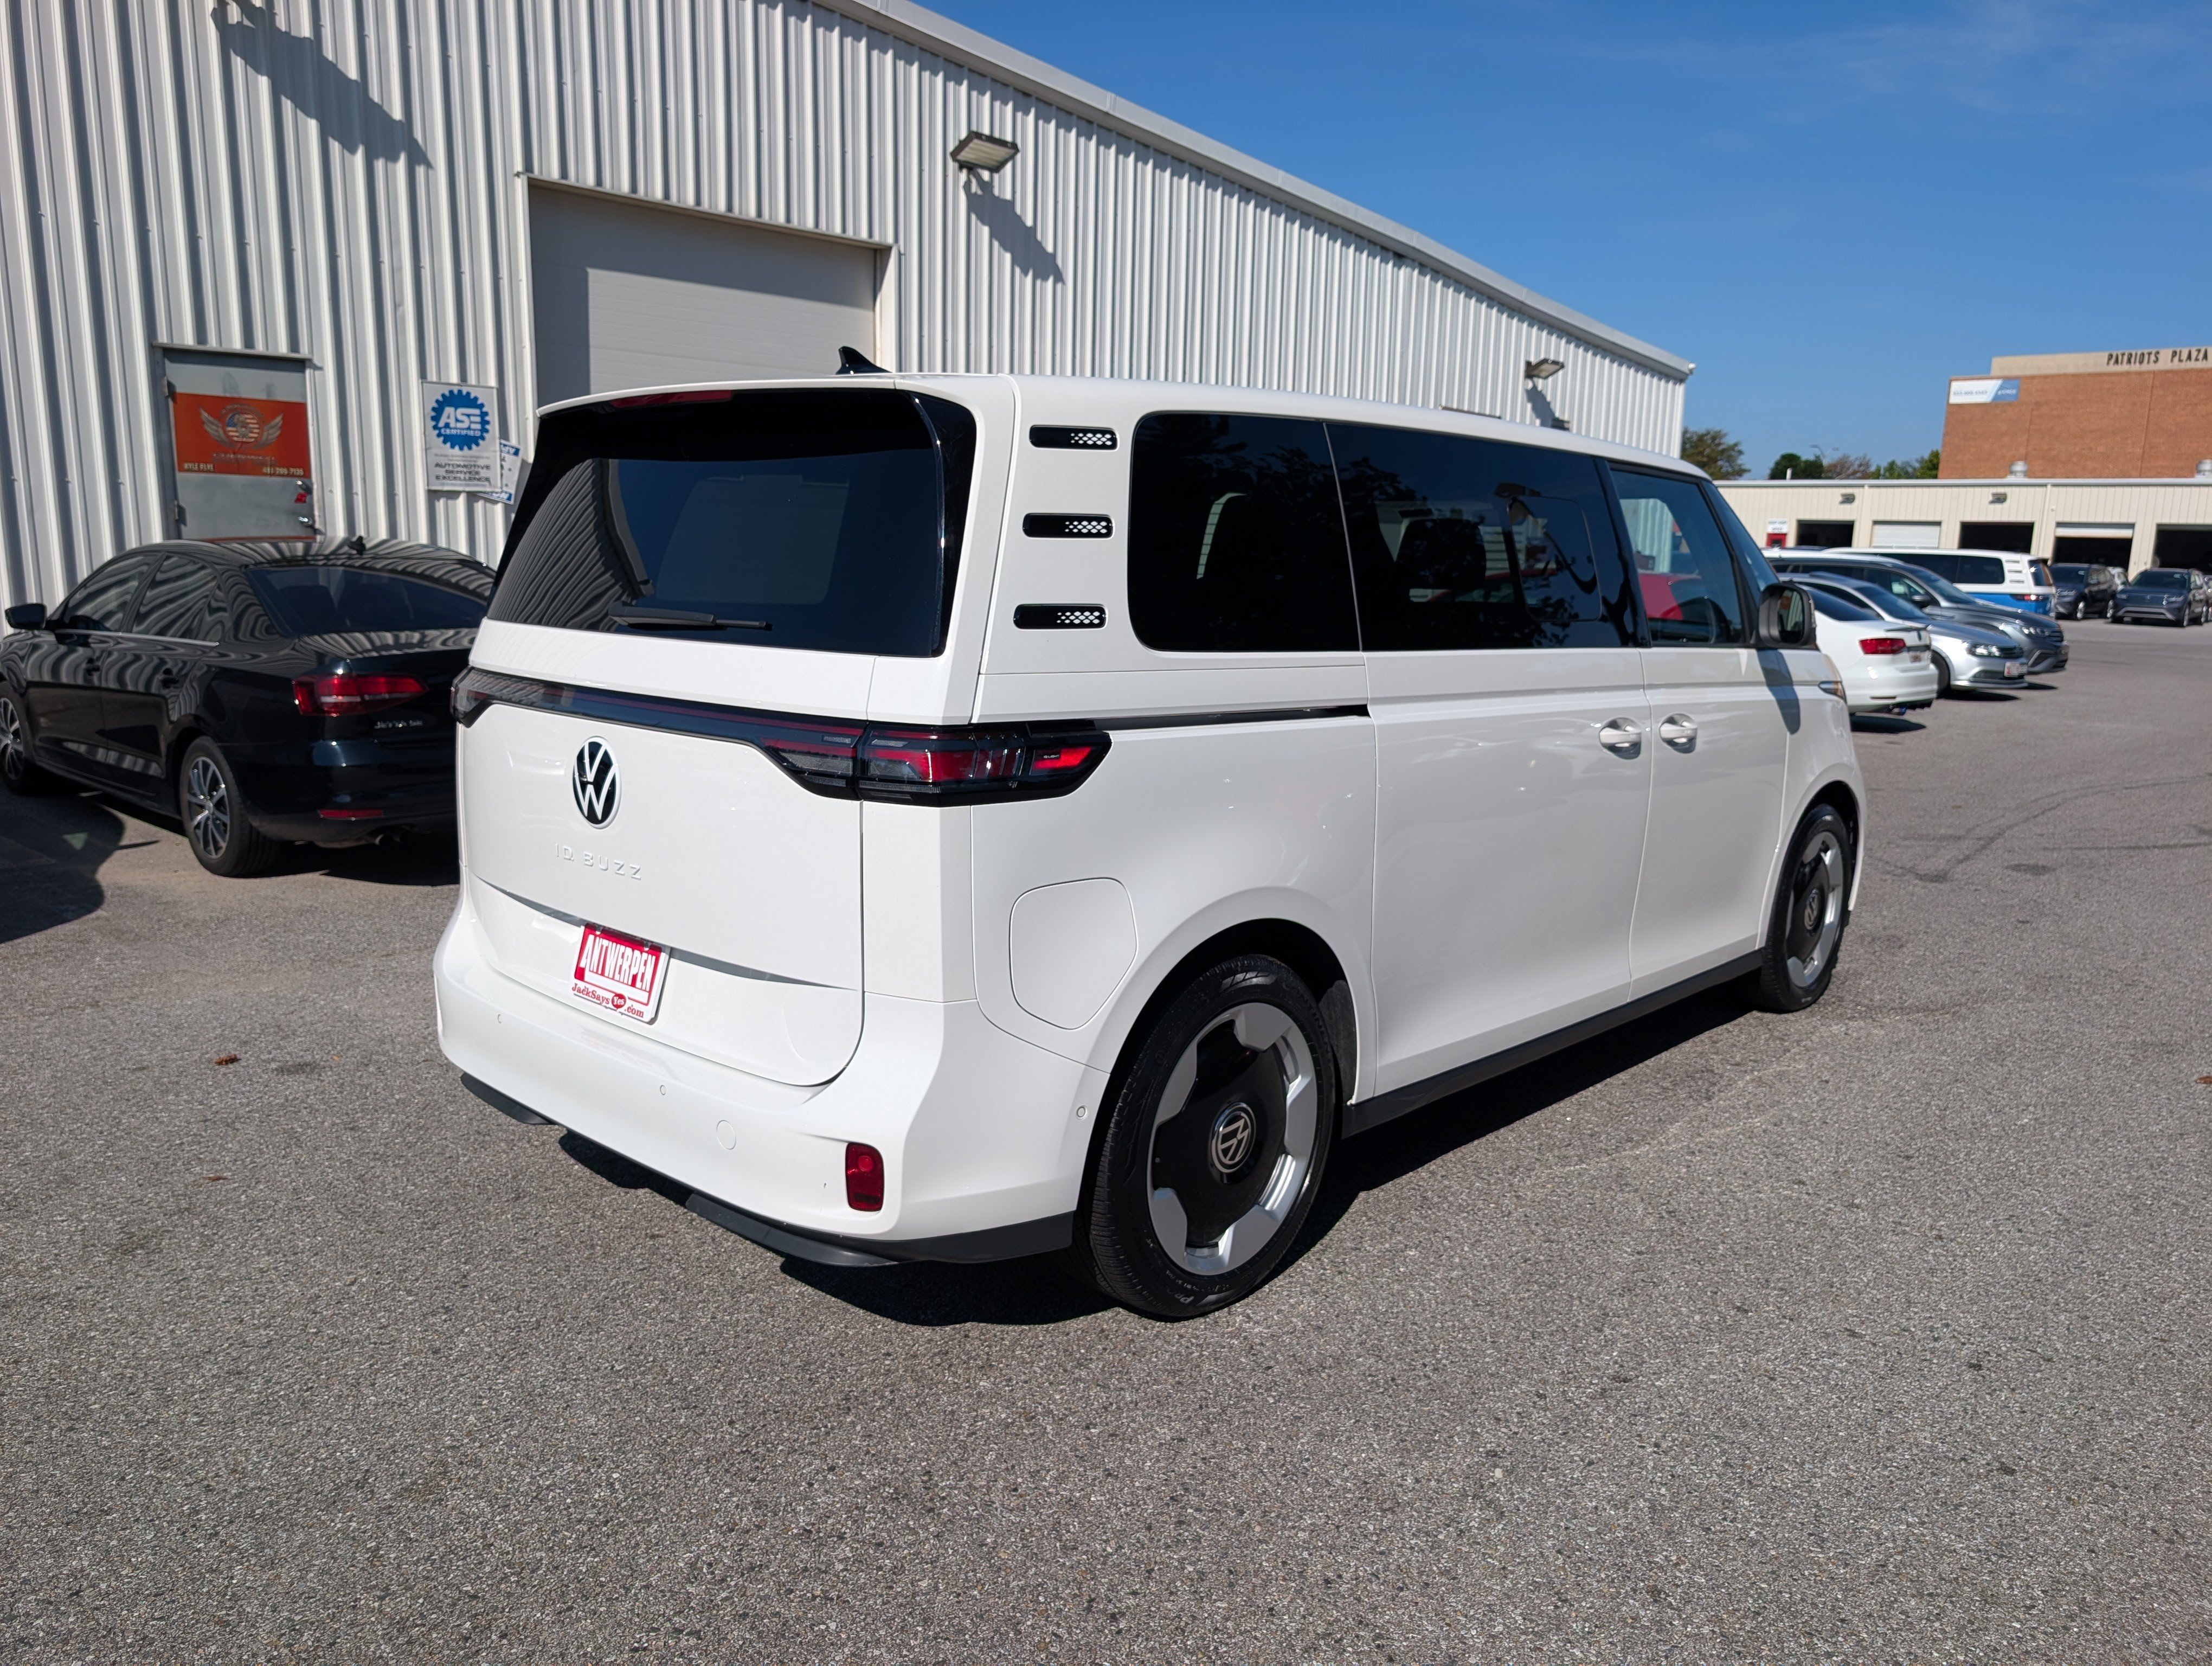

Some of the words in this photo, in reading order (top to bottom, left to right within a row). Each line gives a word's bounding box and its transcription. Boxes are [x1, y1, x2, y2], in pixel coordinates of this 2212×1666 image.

[2106, 350, 2160, 366] PATRIOTS
[2170, 348, 2208, 363] PLAZA
[438, 406, 481, 430] ASE
[440, 428, 481, 436] CERTIFIED
[435, 462, 491, 470] AUTOMOTIVE
[583, 851, 641, 881] BUZZ
[580, 934, 656, 992] ANTWERPEN
